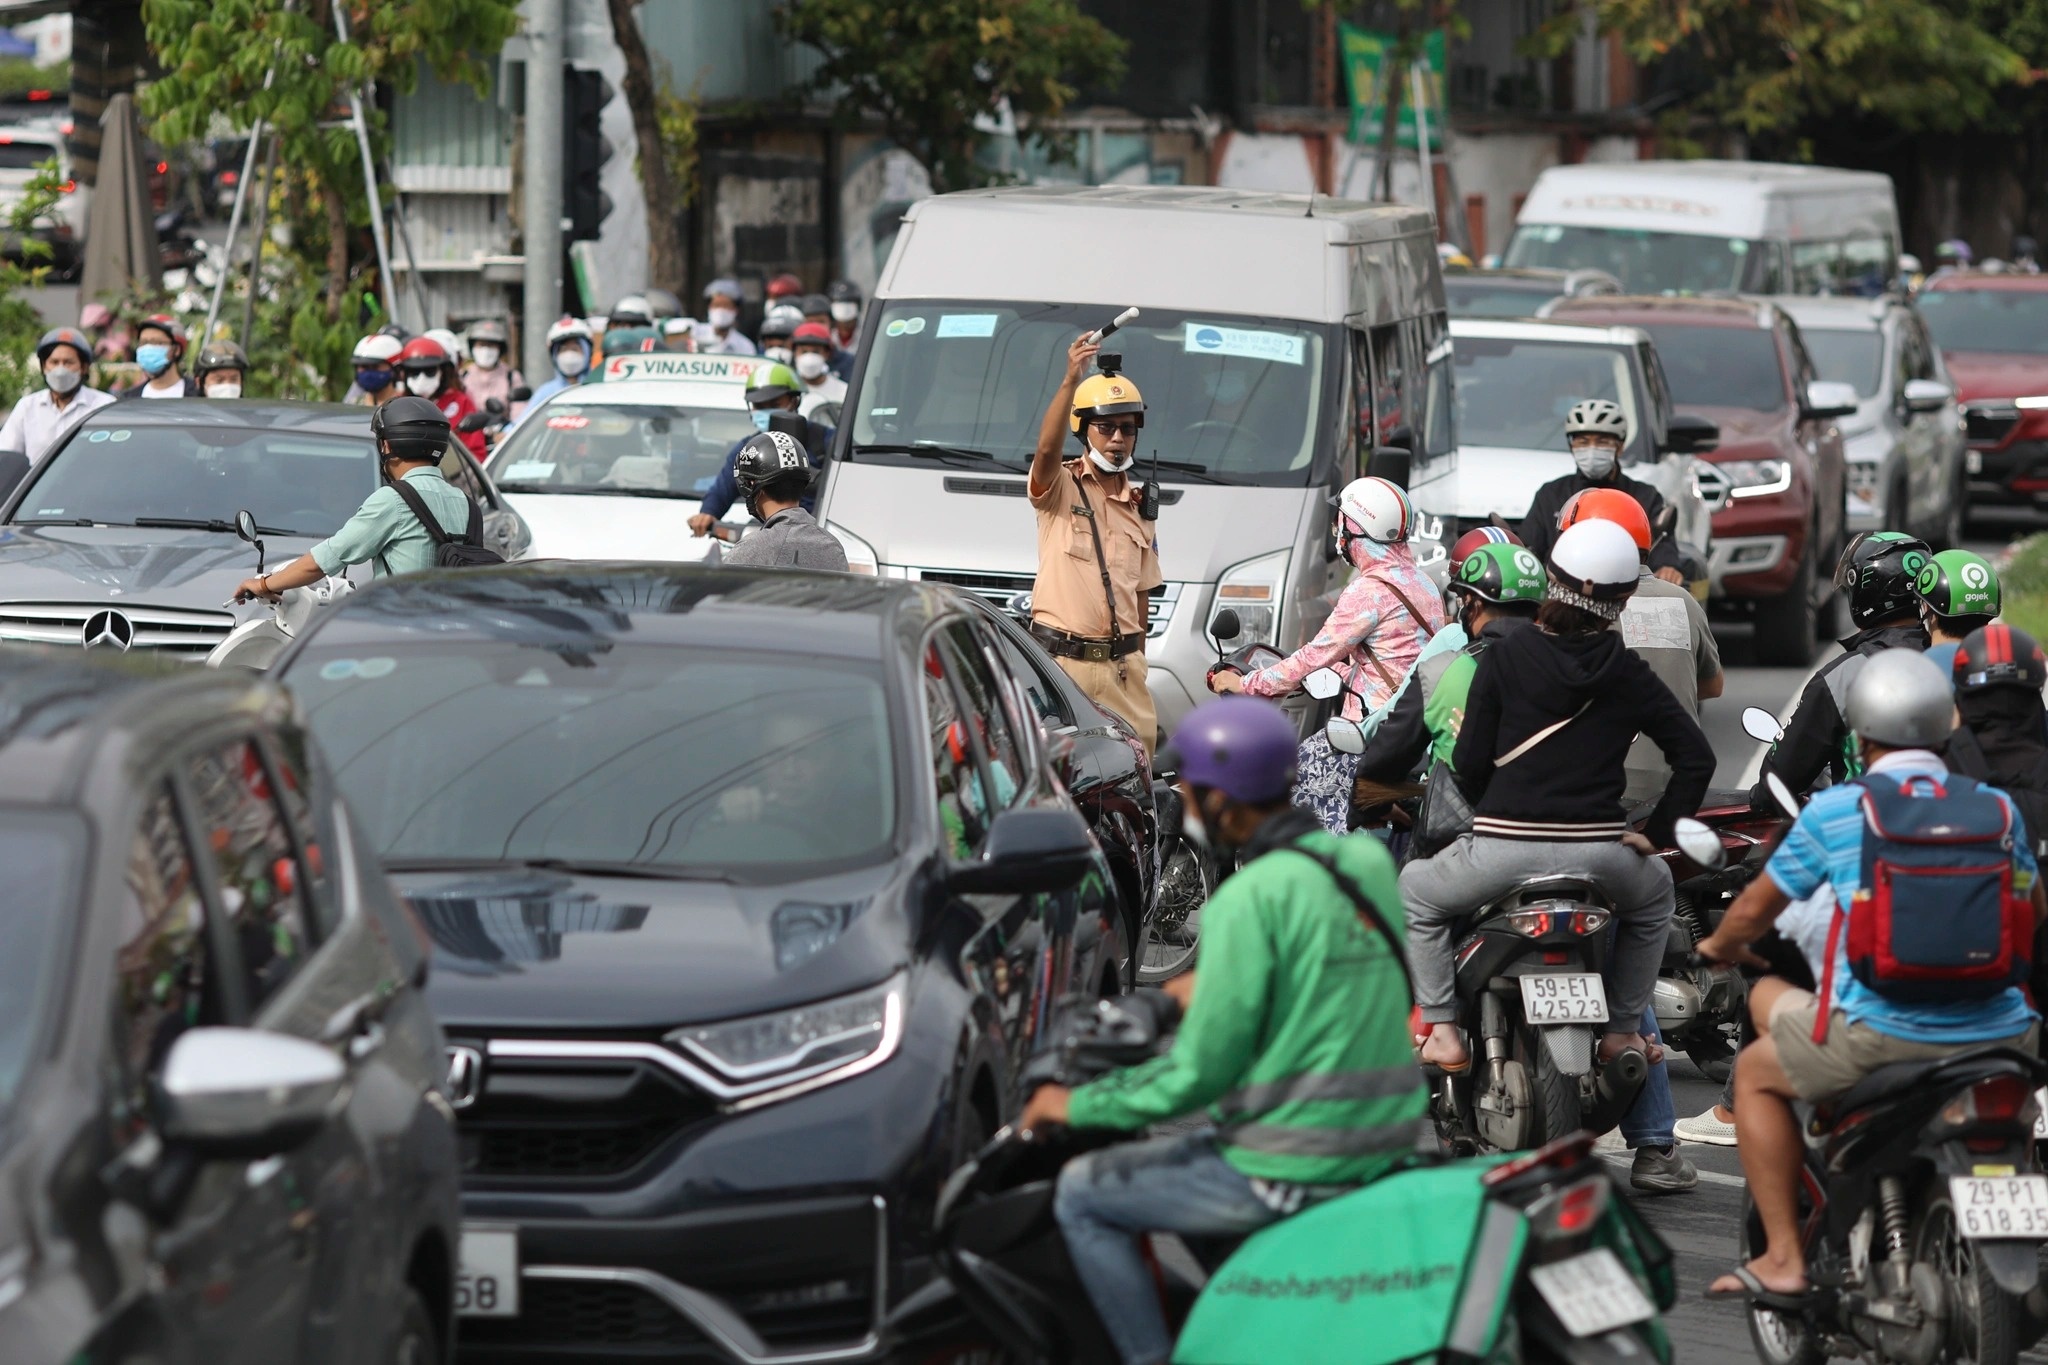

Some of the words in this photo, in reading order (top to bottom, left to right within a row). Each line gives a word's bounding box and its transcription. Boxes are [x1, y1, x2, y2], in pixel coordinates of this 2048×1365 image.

[1285, 339, 1295, 357] 2
[643, 359, 729, 376] VINASUN
[732, 361, 757, 377] TA
[1518, 578, 1540, 589] gojek
[1965, 592, 1989, 602] gojek
[1534, 978, 1589, 998] 59-E1
[1532, 999, 1602, 1020] 425.23
[1967, 1180, 2035, 1205] 29-P1
[1965, 1208, 2048, 1233] 618.35
